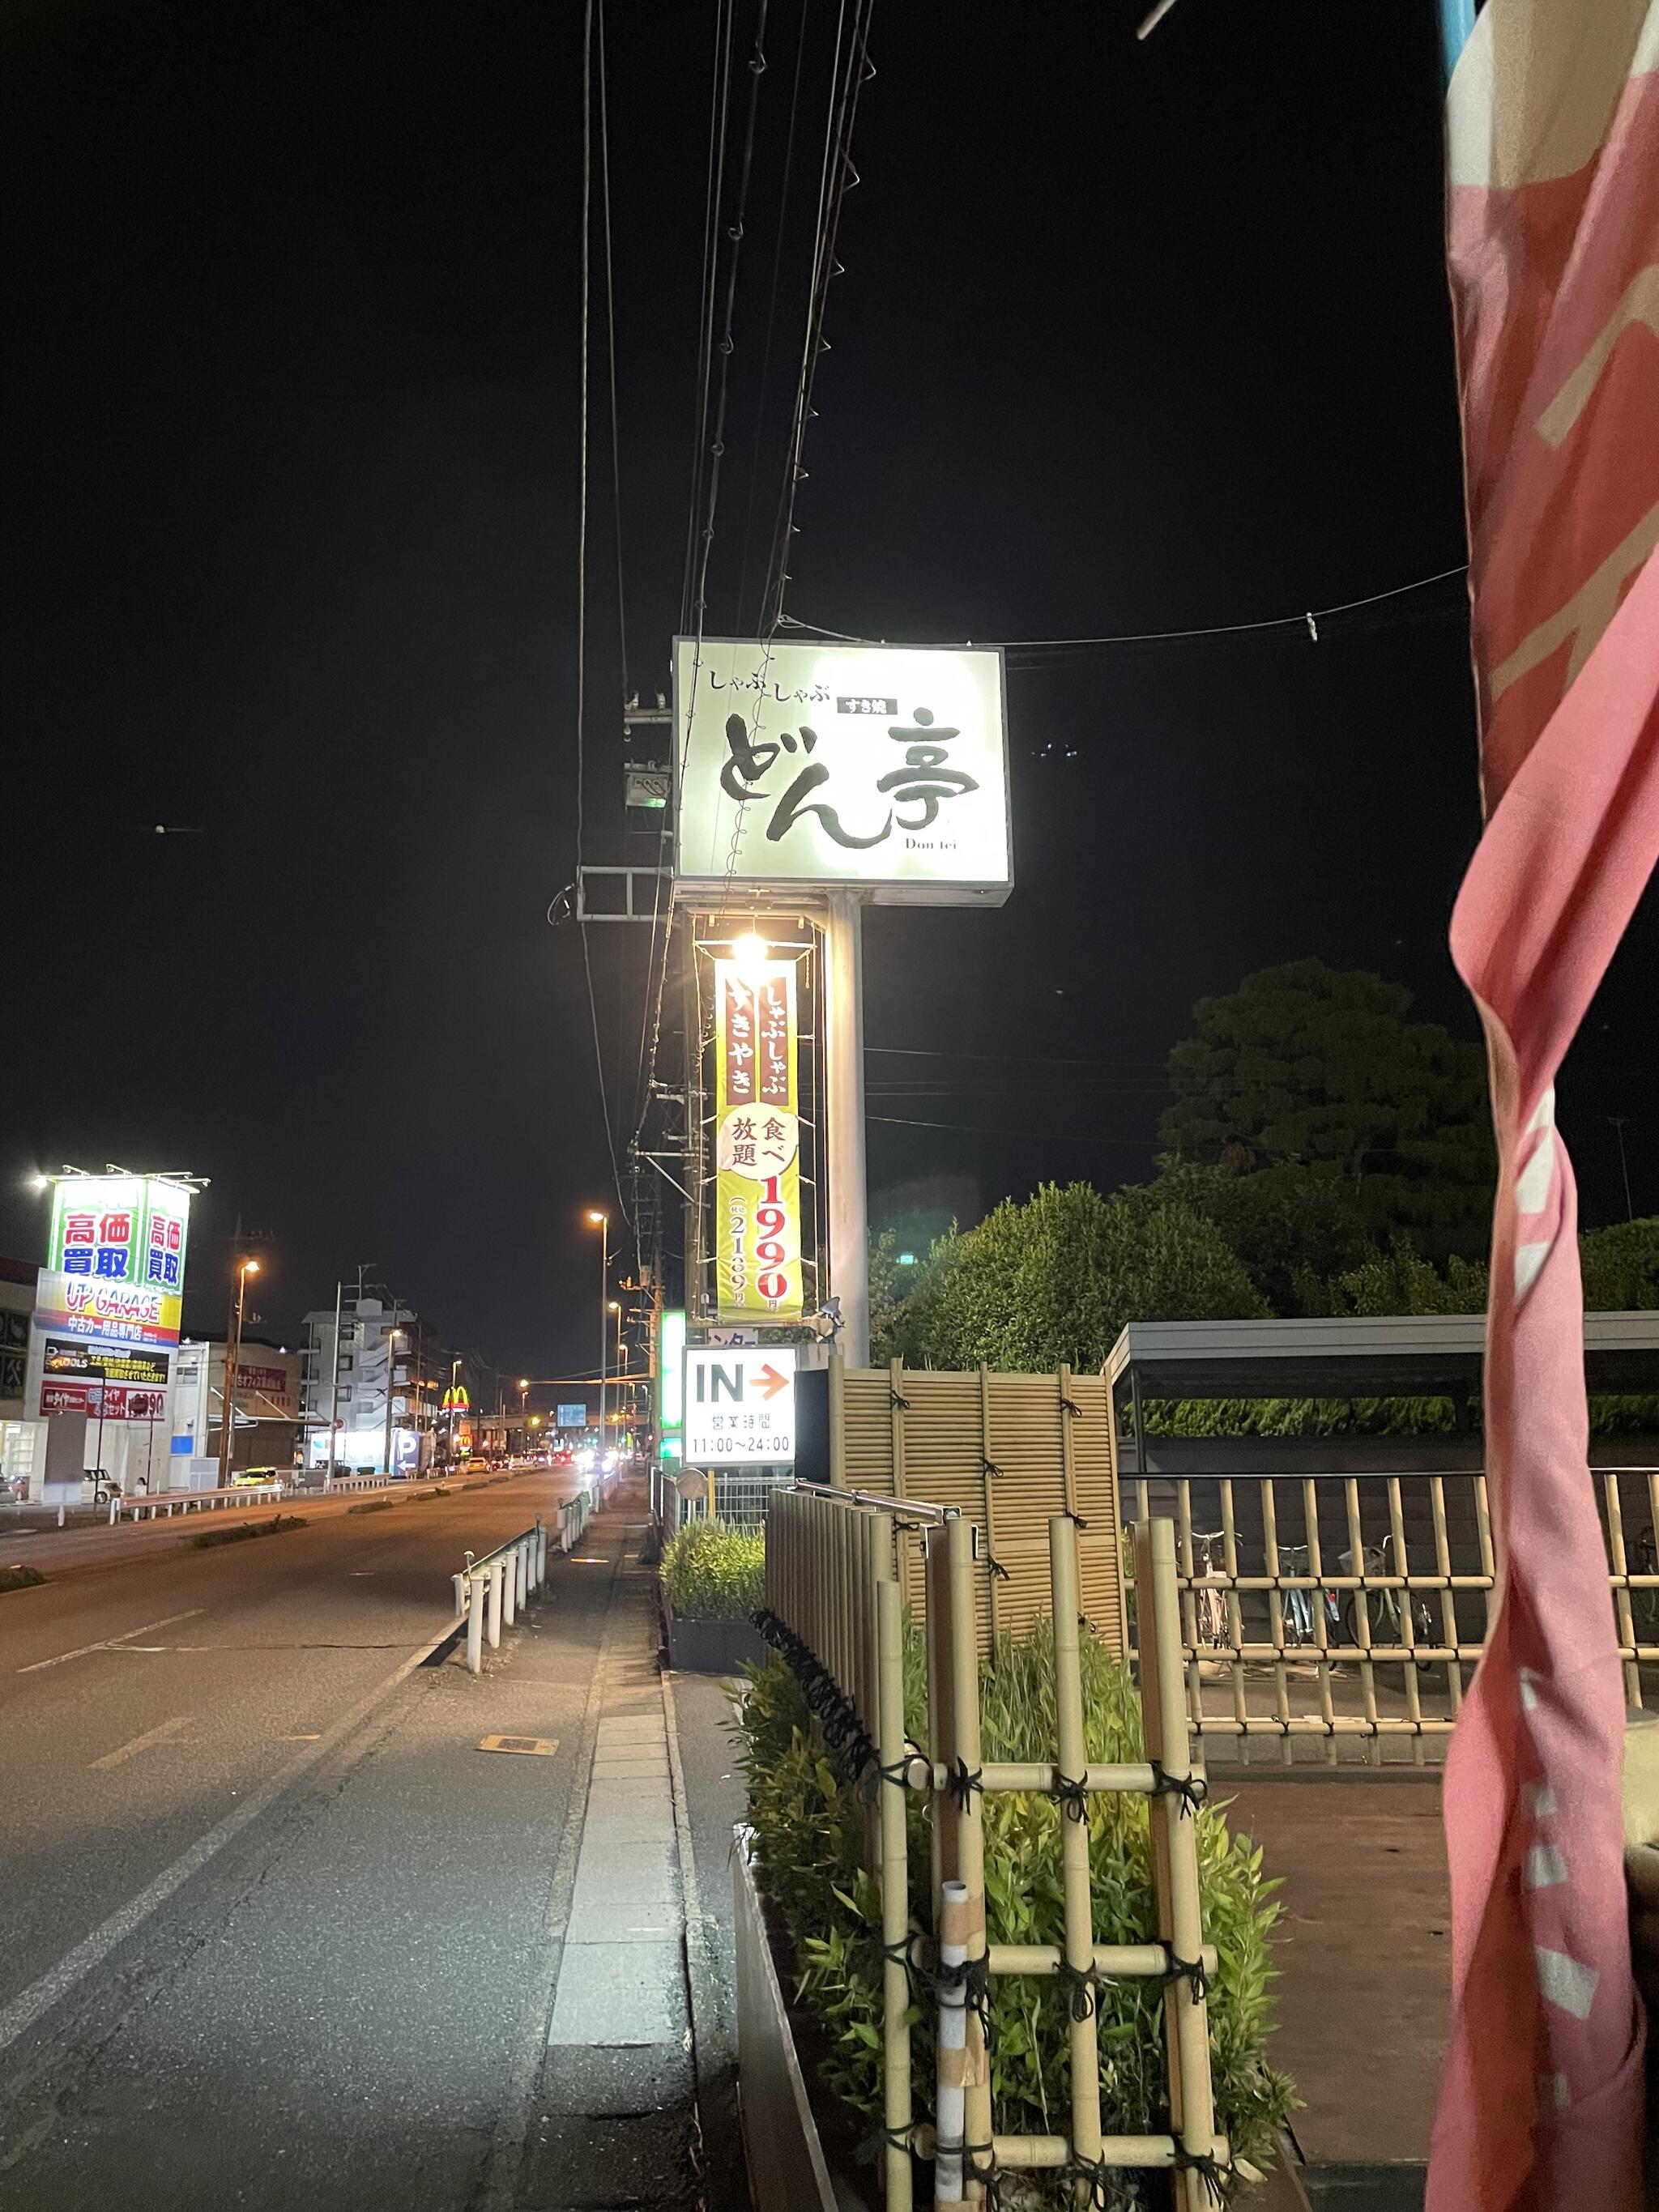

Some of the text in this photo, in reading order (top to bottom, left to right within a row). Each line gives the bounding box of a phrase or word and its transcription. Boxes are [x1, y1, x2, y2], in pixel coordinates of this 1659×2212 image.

[905, 837, 935, 850] Don
[761, 985, 787, 1095] しゃぶしゃぶ
[66, 1213, 130, 1244] 高価
[151, 1215, 181, 1251] 高価
[64, 1247, 128, 1277] 買取
[148, 1248, 179, 1283] 買取
[696, 1363, 744, 1403] IN
